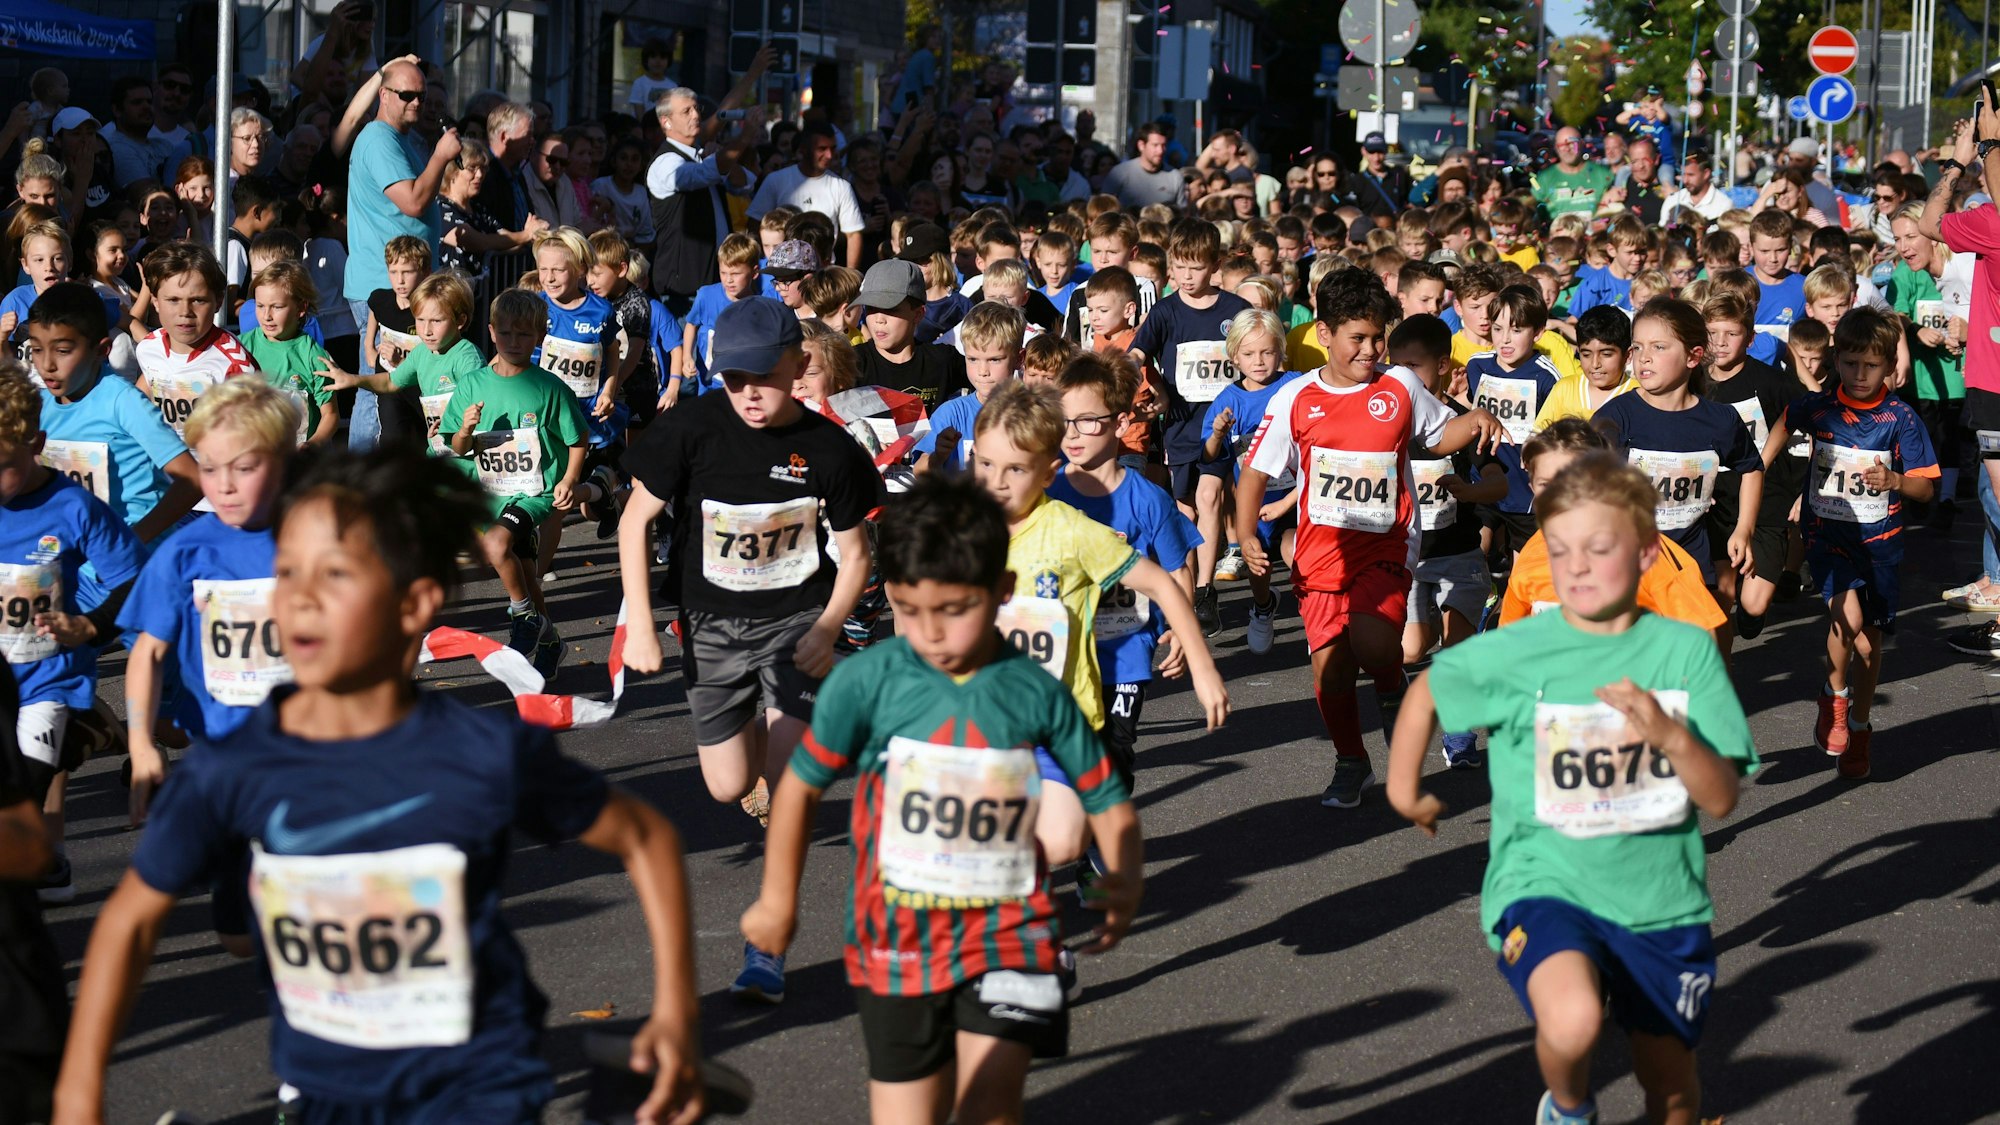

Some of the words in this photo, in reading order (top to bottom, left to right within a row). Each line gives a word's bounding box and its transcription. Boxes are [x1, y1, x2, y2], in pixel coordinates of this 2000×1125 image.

[18, 20, 85, 47] Volksbank
[547, 353, 597, 378] 7496
[1183, 360, 1235, 380] 7676
[154, 396, 199, 424] 709
[1477, 395, 1528, 420] 6684
[478, 450, 534, 473] 6585
[1319, 472, 1389, 504] 7204
[1652, 474, 1704, 502] 481
[502, 512, 520, 524] JAKO
[1310, 503, 1334, 513] VOSS
[1370, 511, 1387, 519] AOK
[1687, 506, 1702, 514] AOK
[715, 522, 805, 561] 7377
[708, 563, 738, 575] VOSS
[784, 558, 805, 569] AOK
[1116, 615, 1136, 624] AOK
[1115, 683, 1139, 694] JAKO
[1111, 693, 1136, 718] AJ
[900, 790, 1028, 843] 6967
[273, 912, 448, 975] 6662
[1676, 971, 1711, 1021] 10
